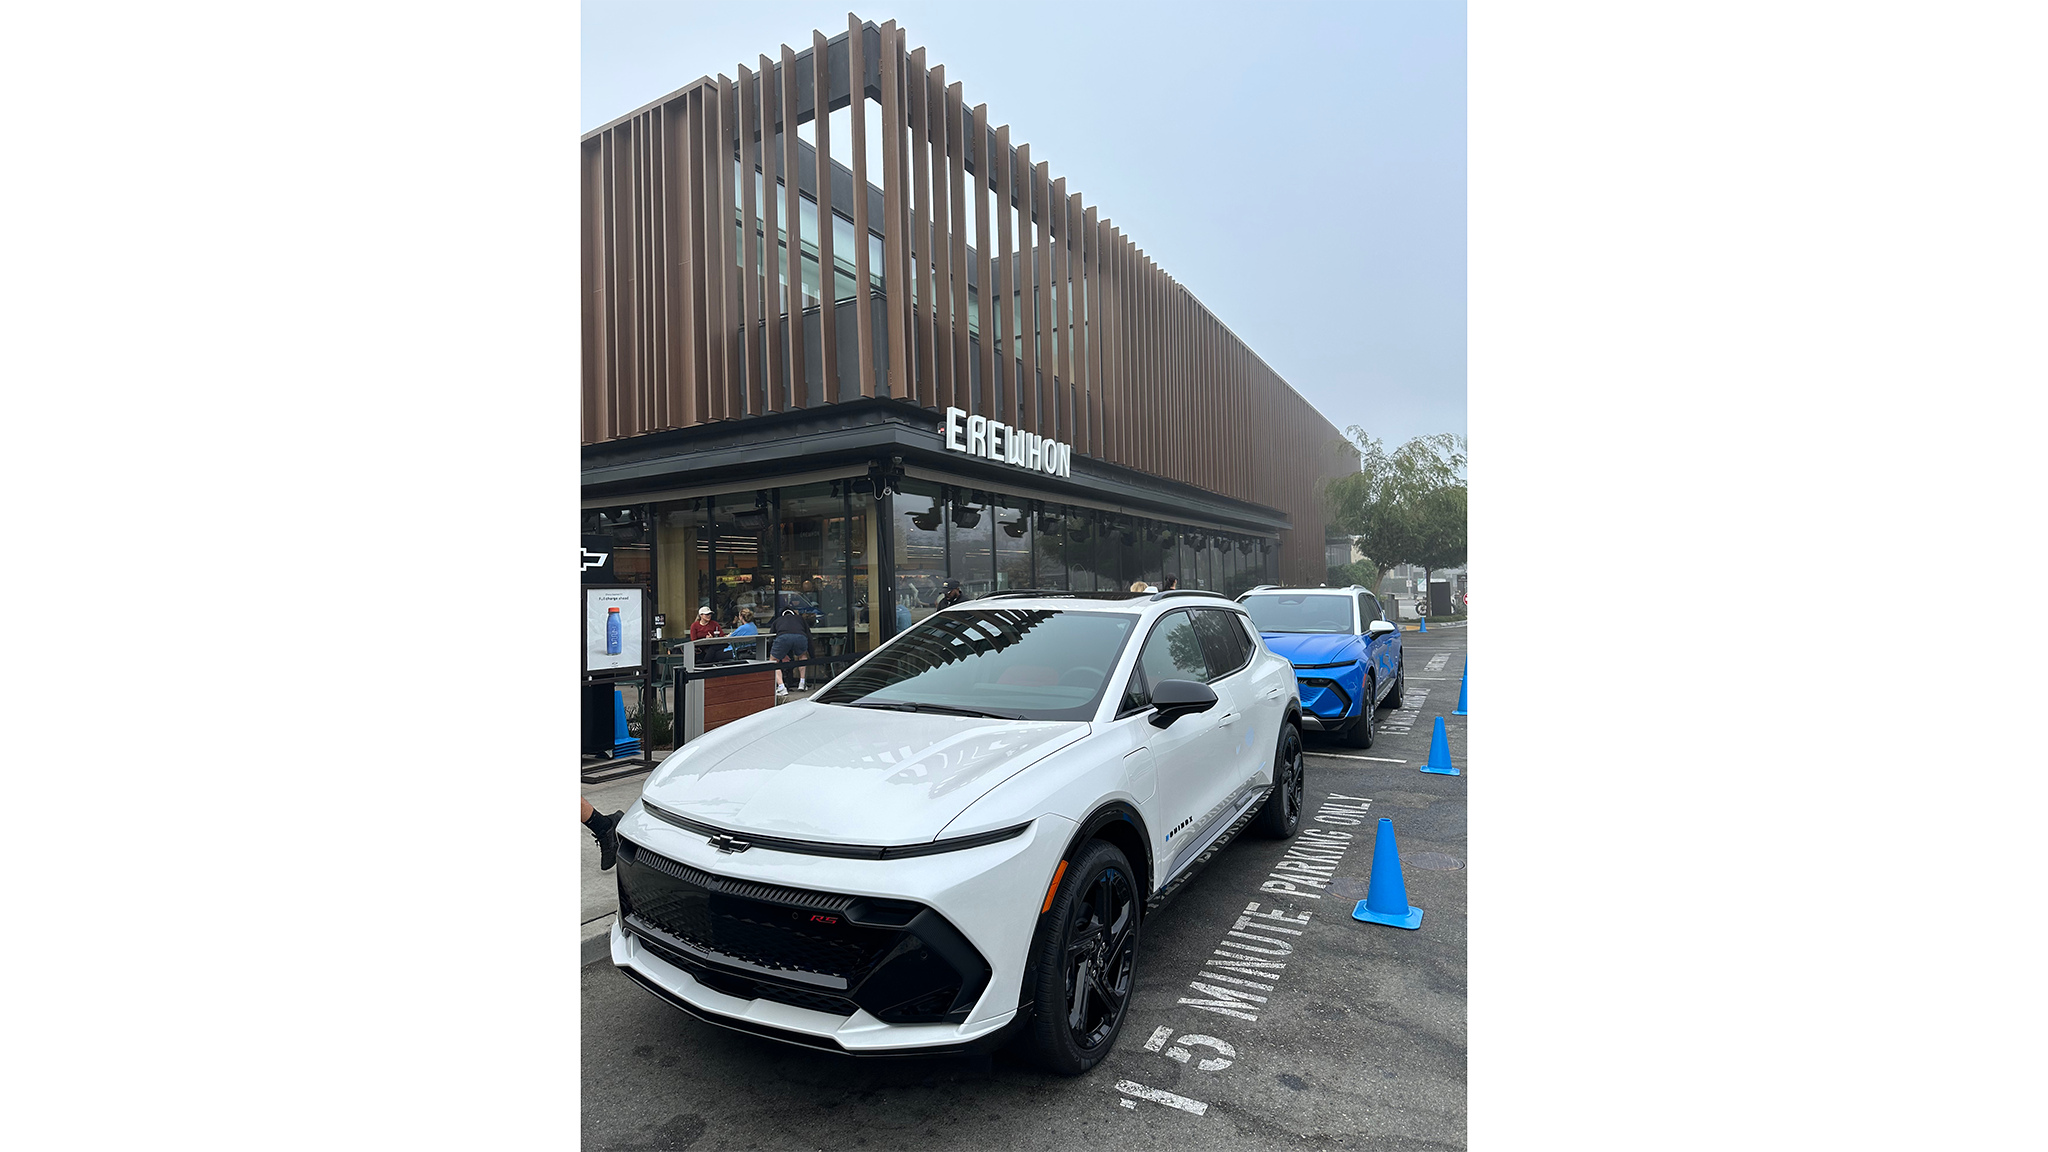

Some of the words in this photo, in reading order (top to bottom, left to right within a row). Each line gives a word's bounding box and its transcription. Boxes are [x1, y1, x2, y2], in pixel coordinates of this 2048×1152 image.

[946, 406, 1070, 478] EREWHON
[810, 914, 838, 924] RS
[1115, 1025, 1236, 1116] 15
[1177, 901, 1313, 1022] MINUTE
[1260, 829, 1354, 899] PARKING
[1313, 792, 1373, 826] ONLY
